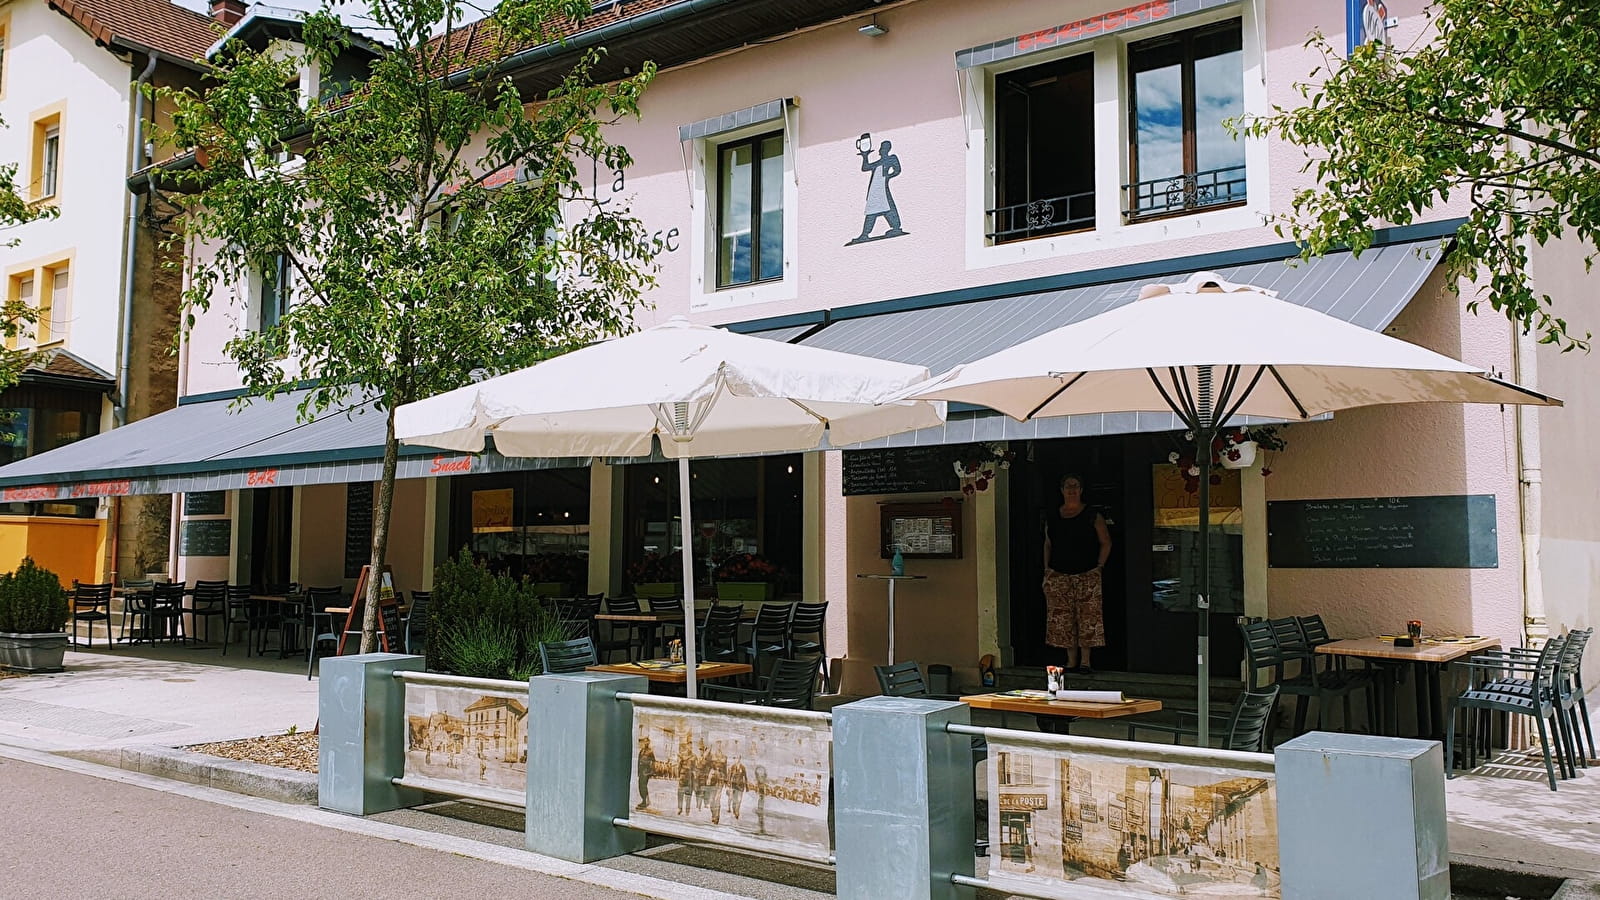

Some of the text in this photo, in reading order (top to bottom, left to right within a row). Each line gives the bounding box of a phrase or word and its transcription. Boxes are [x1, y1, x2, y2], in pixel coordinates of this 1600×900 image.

[1017, 0, 1170, 50] BRASSERIE
[430, 455, 473, 473] Snack
[246, 468, 278, 486] BAR
[1020, 797, 1044, 807] POSTE
